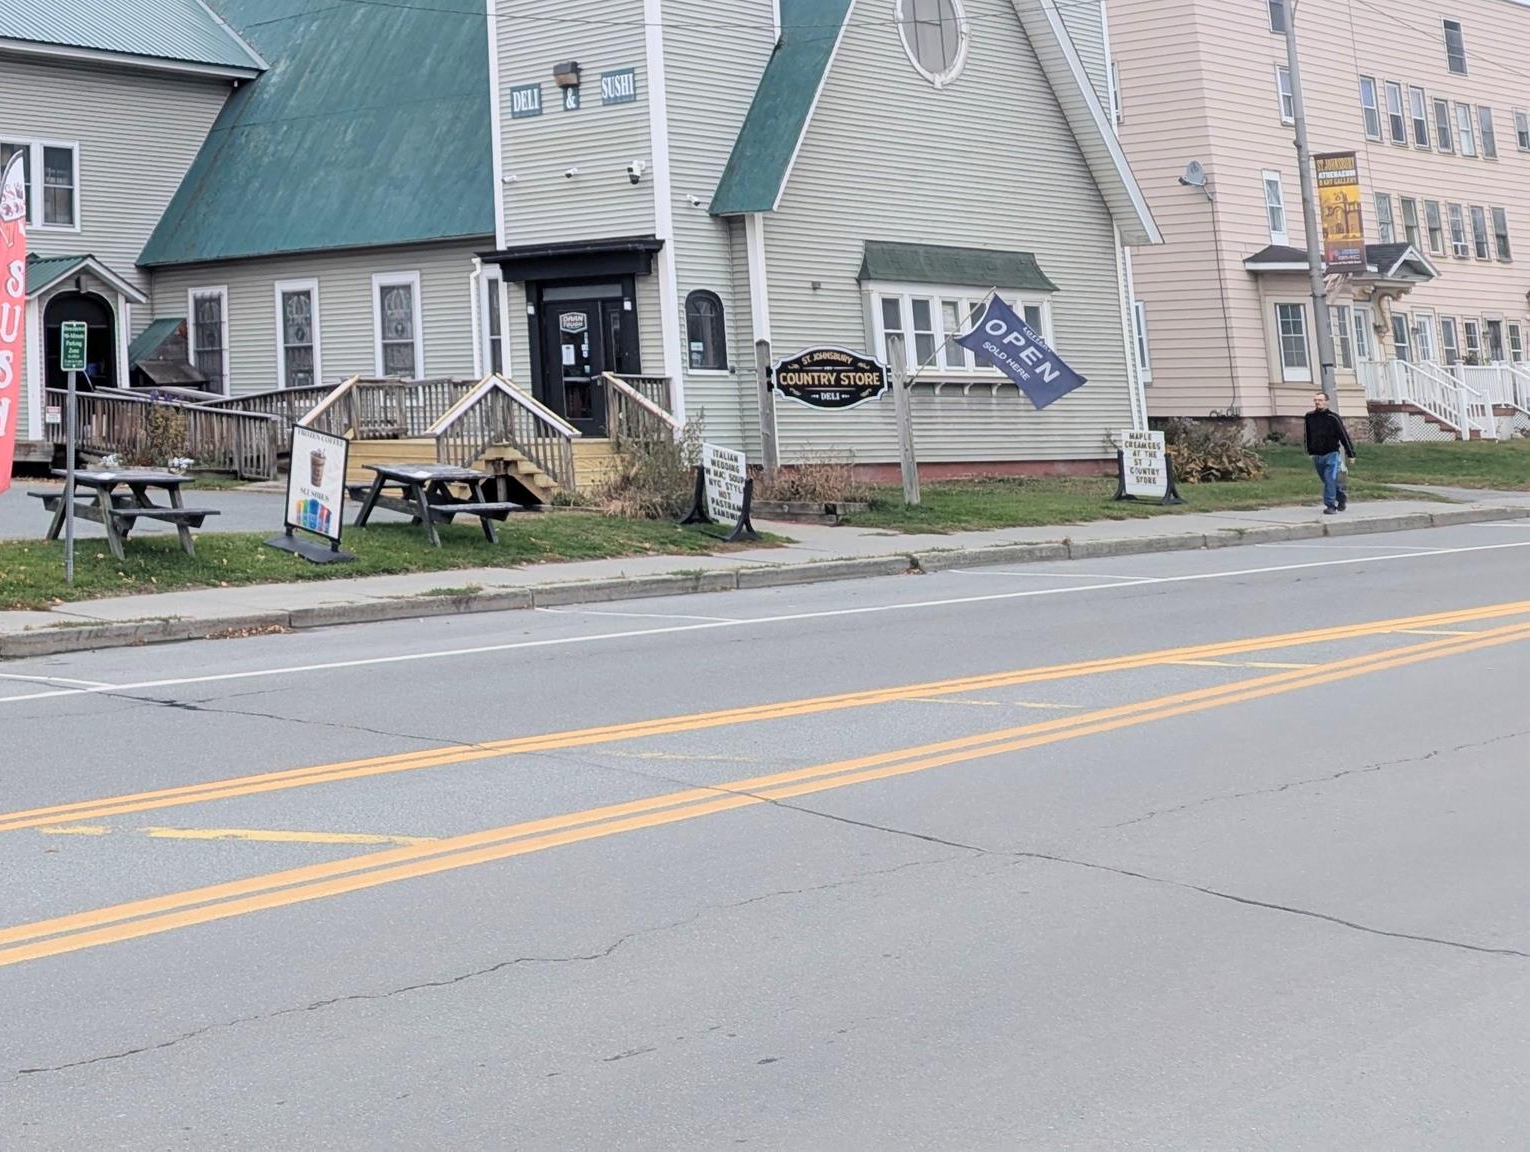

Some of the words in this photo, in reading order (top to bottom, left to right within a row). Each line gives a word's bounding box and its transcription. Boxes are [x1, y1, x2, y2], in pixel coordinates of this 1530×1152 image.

[513, 89, 540, 112] DELI
[566, 88, 576, 109] &
[601, 73, 634, 98] SUSHI
[813, 351, 853, 365] JOHNSBURY
[985, 319, 1061, 383] OPEN
[982, 341, 1007, 360] SOLD
[1006, 358, 1030, 381] HERE
[779, 372, 836, 385] COUNTRY
[840, 372, 880, 385] STORE
[821, 392, 840, 401] DELI
[297, 429, 320, 442] FROZEN
[321, 434, 344, 447] COFFEE
[1129, 432, 1152, 440] MAPLE
[713, 449, 738, 463] ITALIAN
[711, 458, 740, 473] WEDDING
[1130, 467, 1159, 475] COUNTRY
[713, 469, 726, 480] MAC
[728, 472, 744, 484] SOUP
[1136, 476, 1157, 484] STORE
[709, 478, 722, 488] NYC
[725, 481, 742, 494] STYL
[718, 489, 731, 500] HOT
[711, 497, 742, 512] PASTRAM
